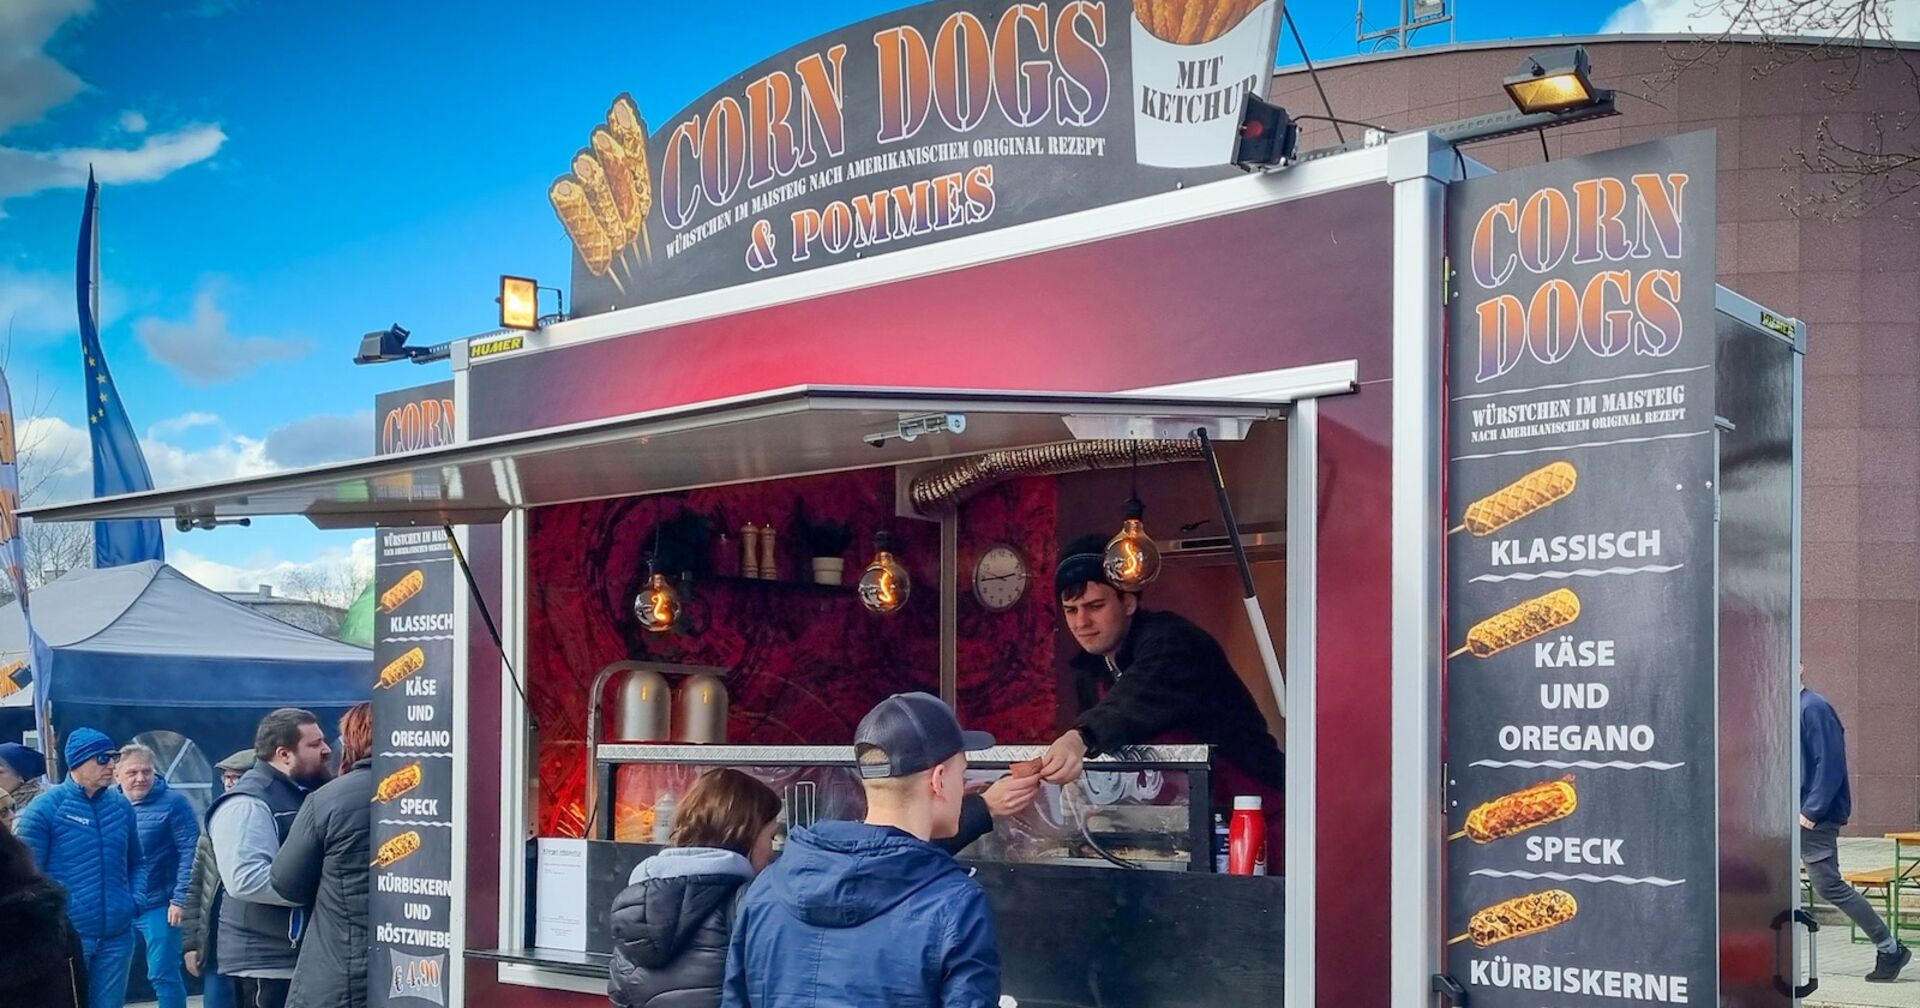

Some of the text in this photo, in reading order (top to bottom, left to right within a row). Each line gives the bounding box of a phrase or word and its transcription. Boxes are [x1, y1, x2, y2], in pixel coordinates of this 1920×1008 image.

[1176, 56, 1223, 89] MIT
[661, 0, 1110, 230] CORN DOGS
[666, 136, 1106, 259] WÜRSTCHEN IM MAISTEIG NACH AMERIKANISCHEM ORIGINAL REZEPT
[745, 164, 995, 272] & POMMES
[1471, 173, 1689, 289] CORN
[1475, 270, 1683, 383] DOGS
[471, 338, 521, 357] HUMER
[1472, 385, 1685, 427] WÜRSTCHEN IM MAISTEIG
[383, 399, 455, 456] CORN
[1471, 408, 1686, 443] NACH AMERIKANISCHEM ORIGINAL REZEPT
[1491, 530, 1661, 566] KLASSISCH
[390, 613, 453, 633] KLASSISCH
[1535, 635, 1615, 668] KÄSE
[405, 676, 436, 696] KÄSE
[1540, 683, 1610, 709] UND
[407, 704, 435, 722] UND
[391, 730, 450, 747] OREGANO
[1498, 725, 1655, 751] OREGANO
[400, 798, 438, 816] SPECK
[1525, 836, 1624, 865] SPECK
[378, 872, 451, 897] KÜRBISKERN
[404, 903, 431, 920] UND
[376, 922, 450, 948] RÖSTZWIEBE
[394, 959, 441, 993] € 4,90
[1470, 956, 1688, 1003] KÜRBISKERNE
